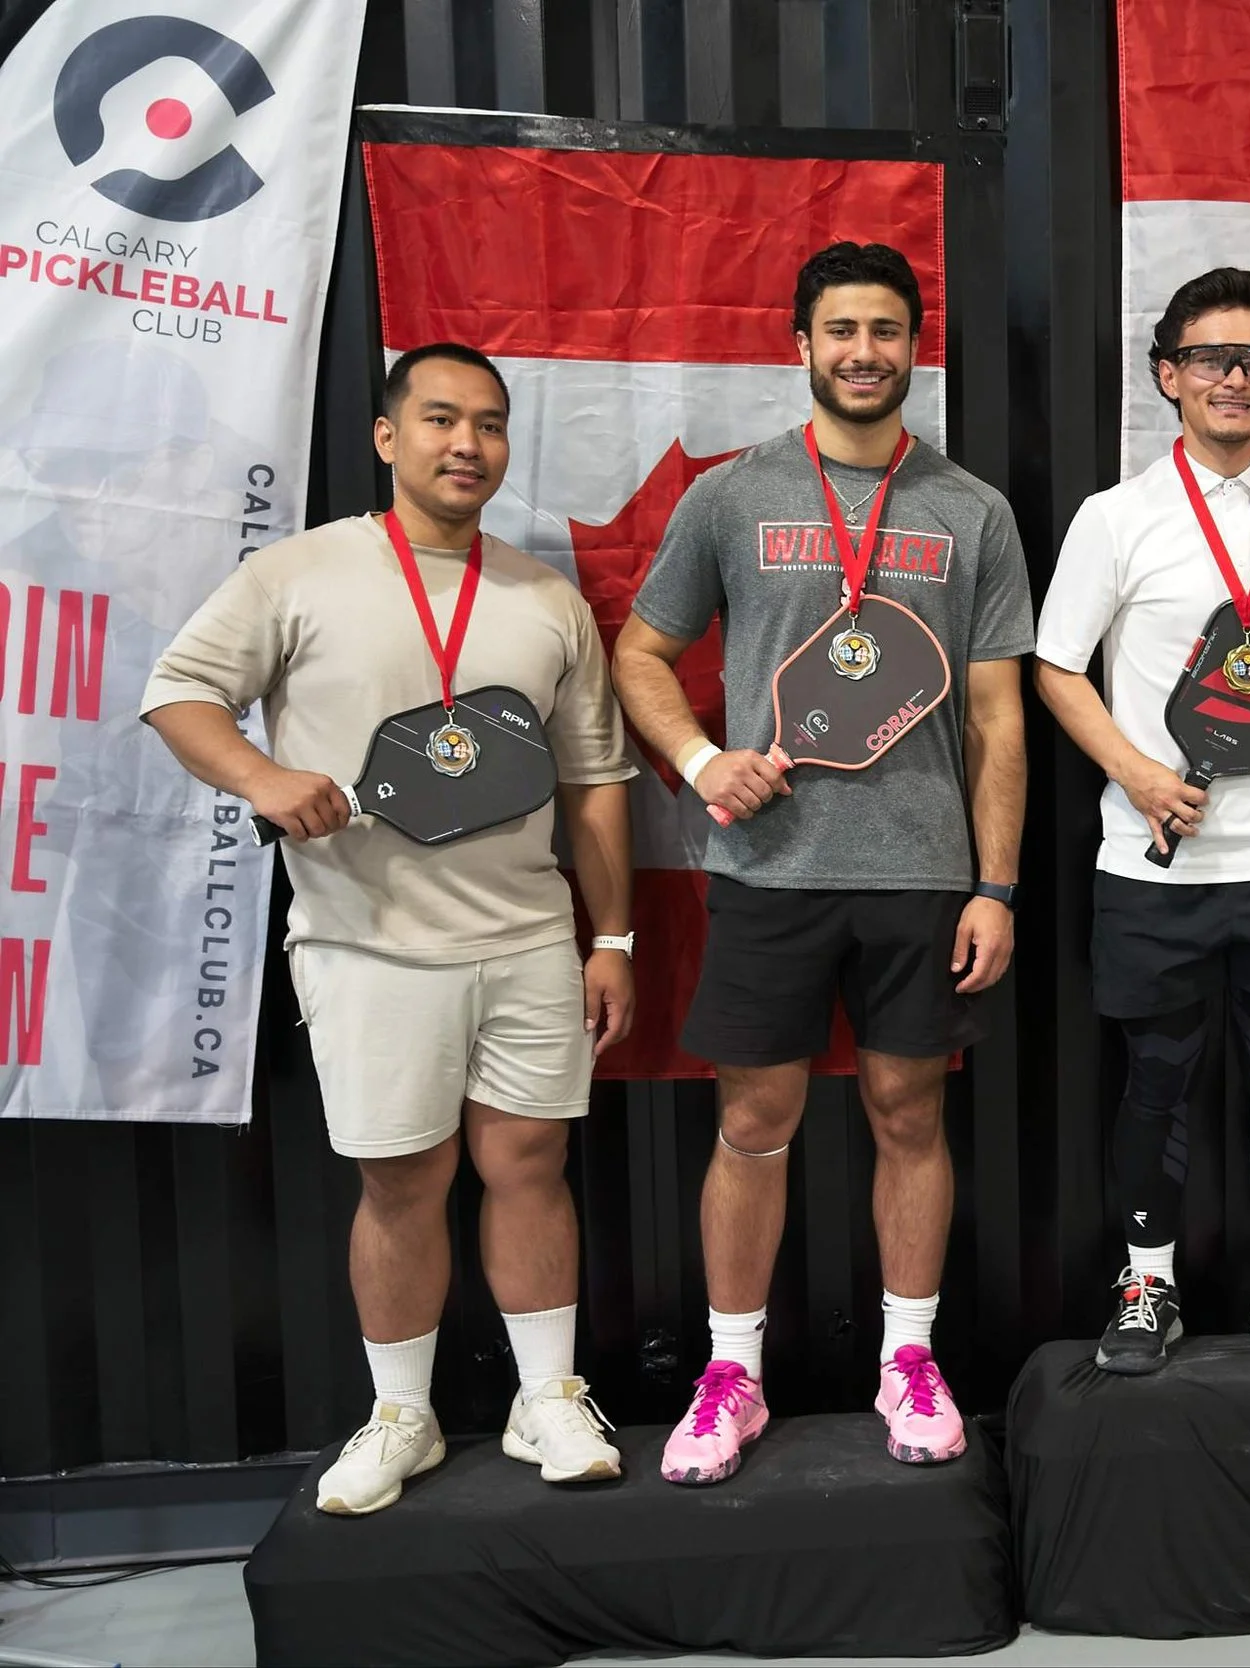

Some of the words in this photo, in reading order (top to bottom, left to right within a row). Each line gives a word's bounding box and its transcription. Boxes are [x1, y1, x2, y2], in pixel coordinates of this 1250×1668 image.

[36, 220, 198, 268] CALGARY
[0, 243, 288, 325] PICKLEBALL
[132, 308, 223, 344] CLUB
[766, 528, 945, 575] WOLACK
[501, 710, 531, 730] RPM
[866, 701, 924, 751] CORAL
